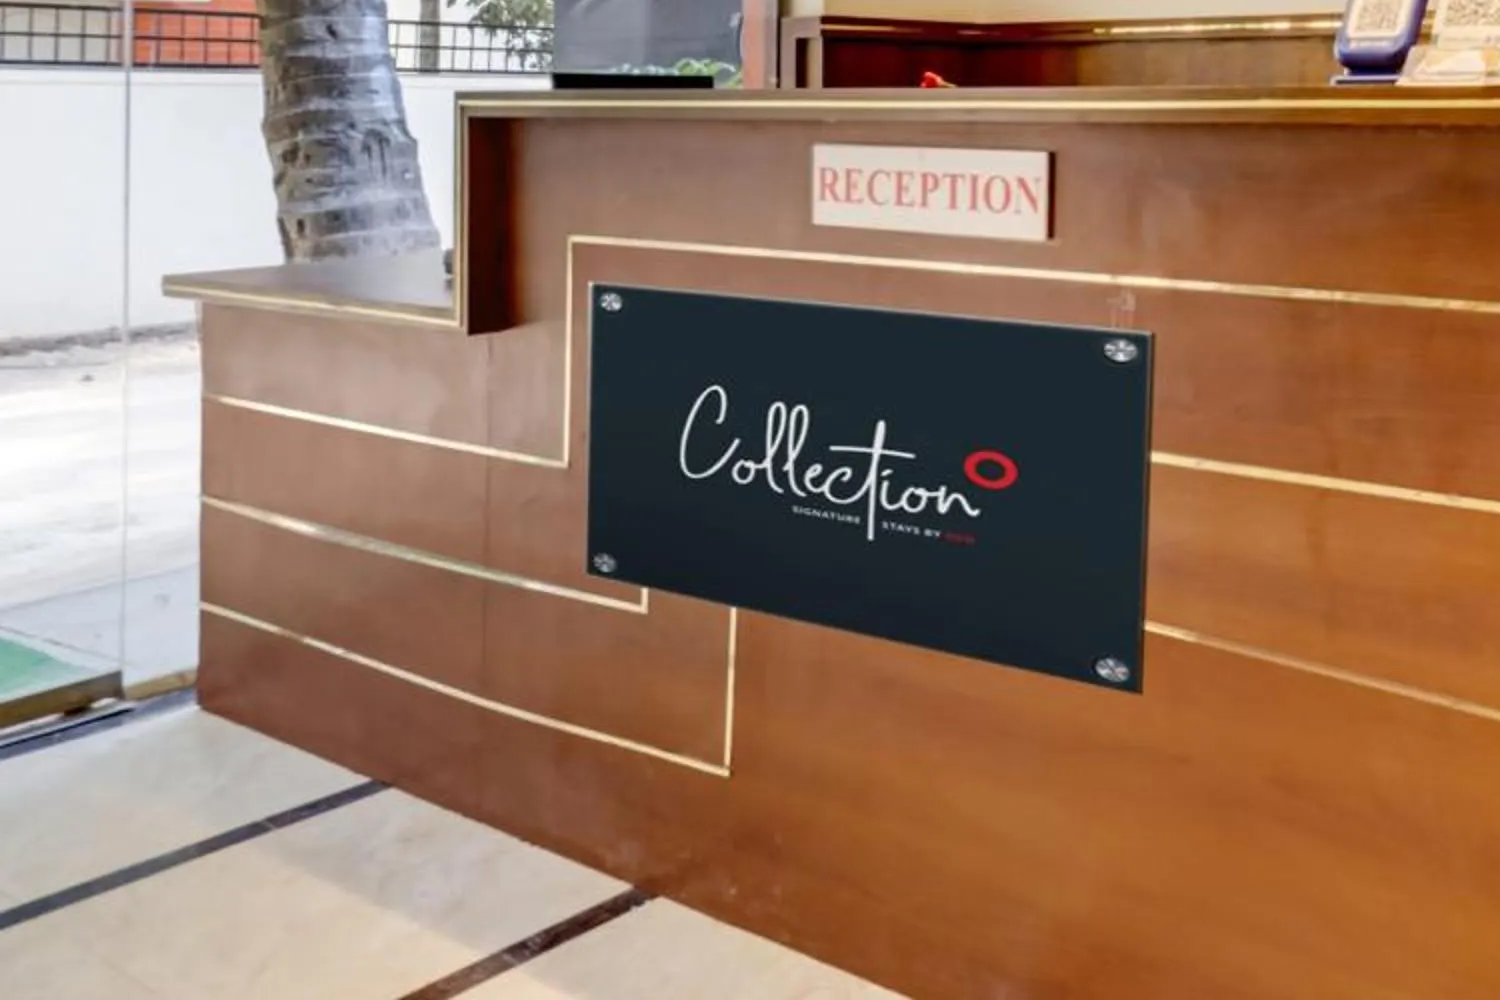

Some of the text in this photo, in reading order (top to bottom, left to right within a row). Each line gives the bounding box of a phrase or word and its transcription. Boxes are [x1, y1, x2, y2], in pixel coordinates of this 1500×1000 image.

[818, 166, 1042, 215] RECEPTION
[679, 384, 980, 540] Collection
[791, 504, 861, 525] SIGNATURE
[881, 520, 921, 536] STAYS
[923, 528, 941, 539] BY
